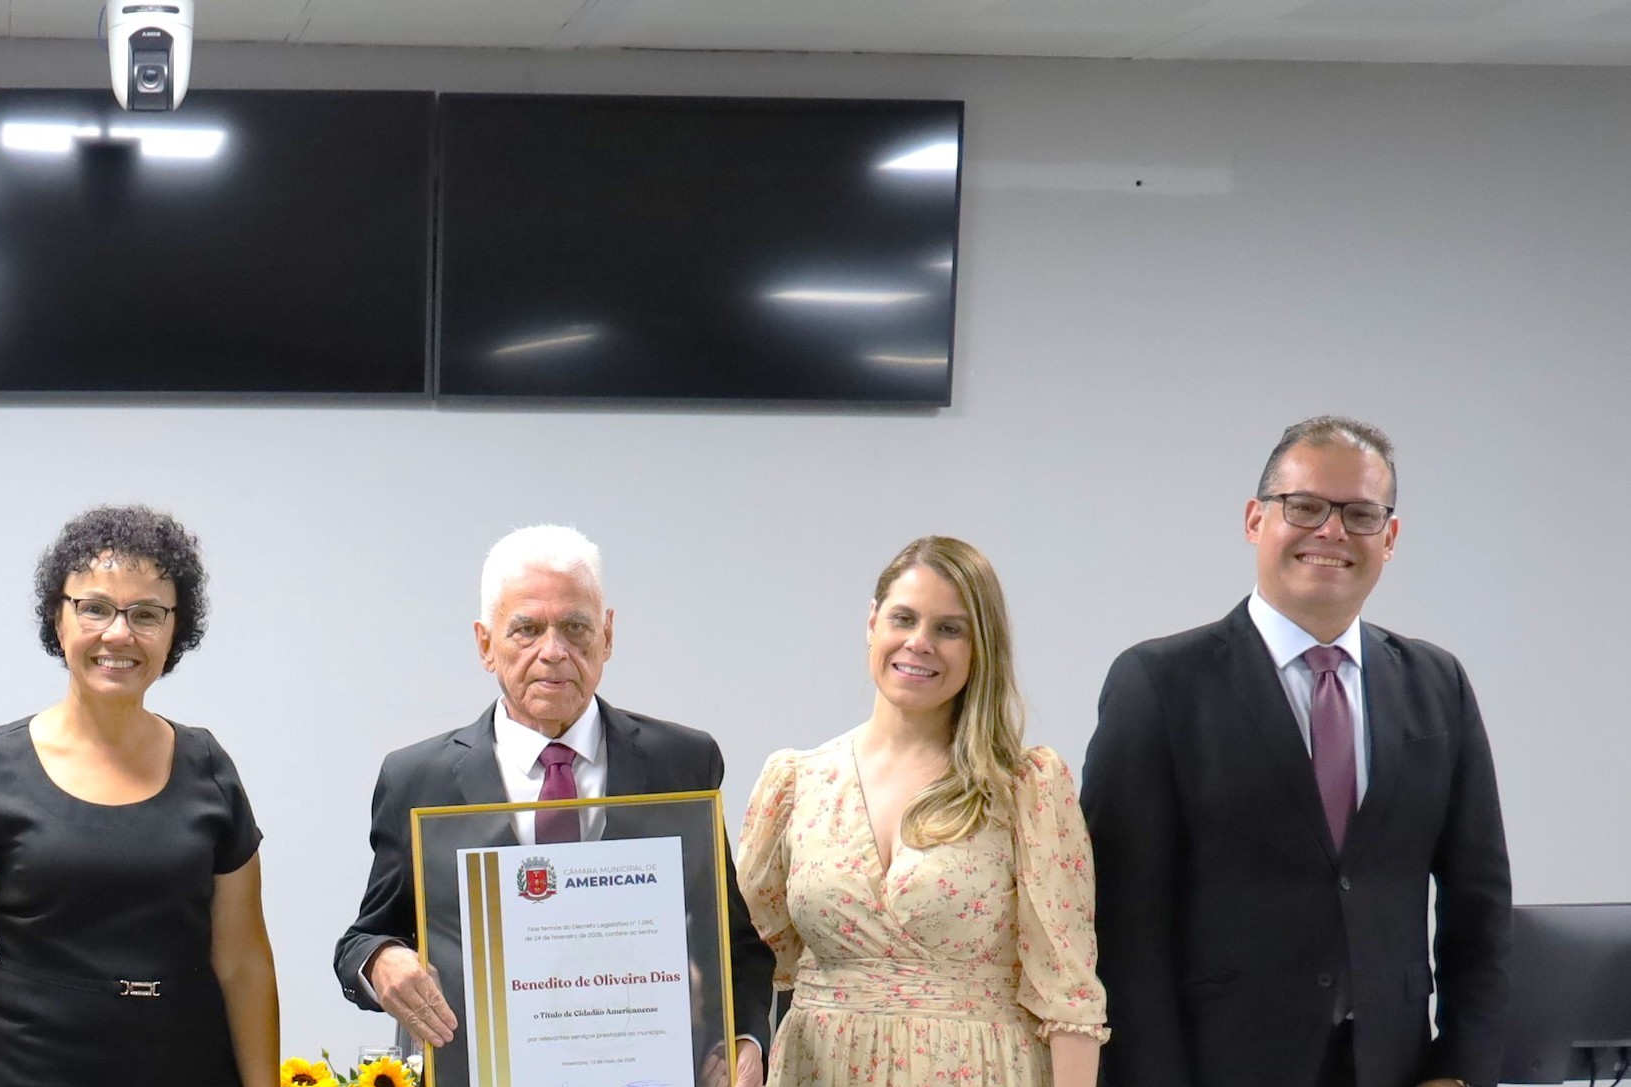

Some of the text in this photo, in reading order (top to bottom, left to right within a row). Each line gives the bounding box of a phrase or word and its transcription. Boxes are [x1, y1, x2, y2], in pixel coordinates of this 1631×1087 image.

[600, 865, 644, 874] MUNICIPAL
[565, 874, 657, 888] AMERICANA
[572, 922, 596, 930] Decreto
[512, 971, 681, 991] Benedito de Oliveira Dias
[574, 1008, 605, 1017] Cidadão
[606, 1006, 658, 1015] Americanense
